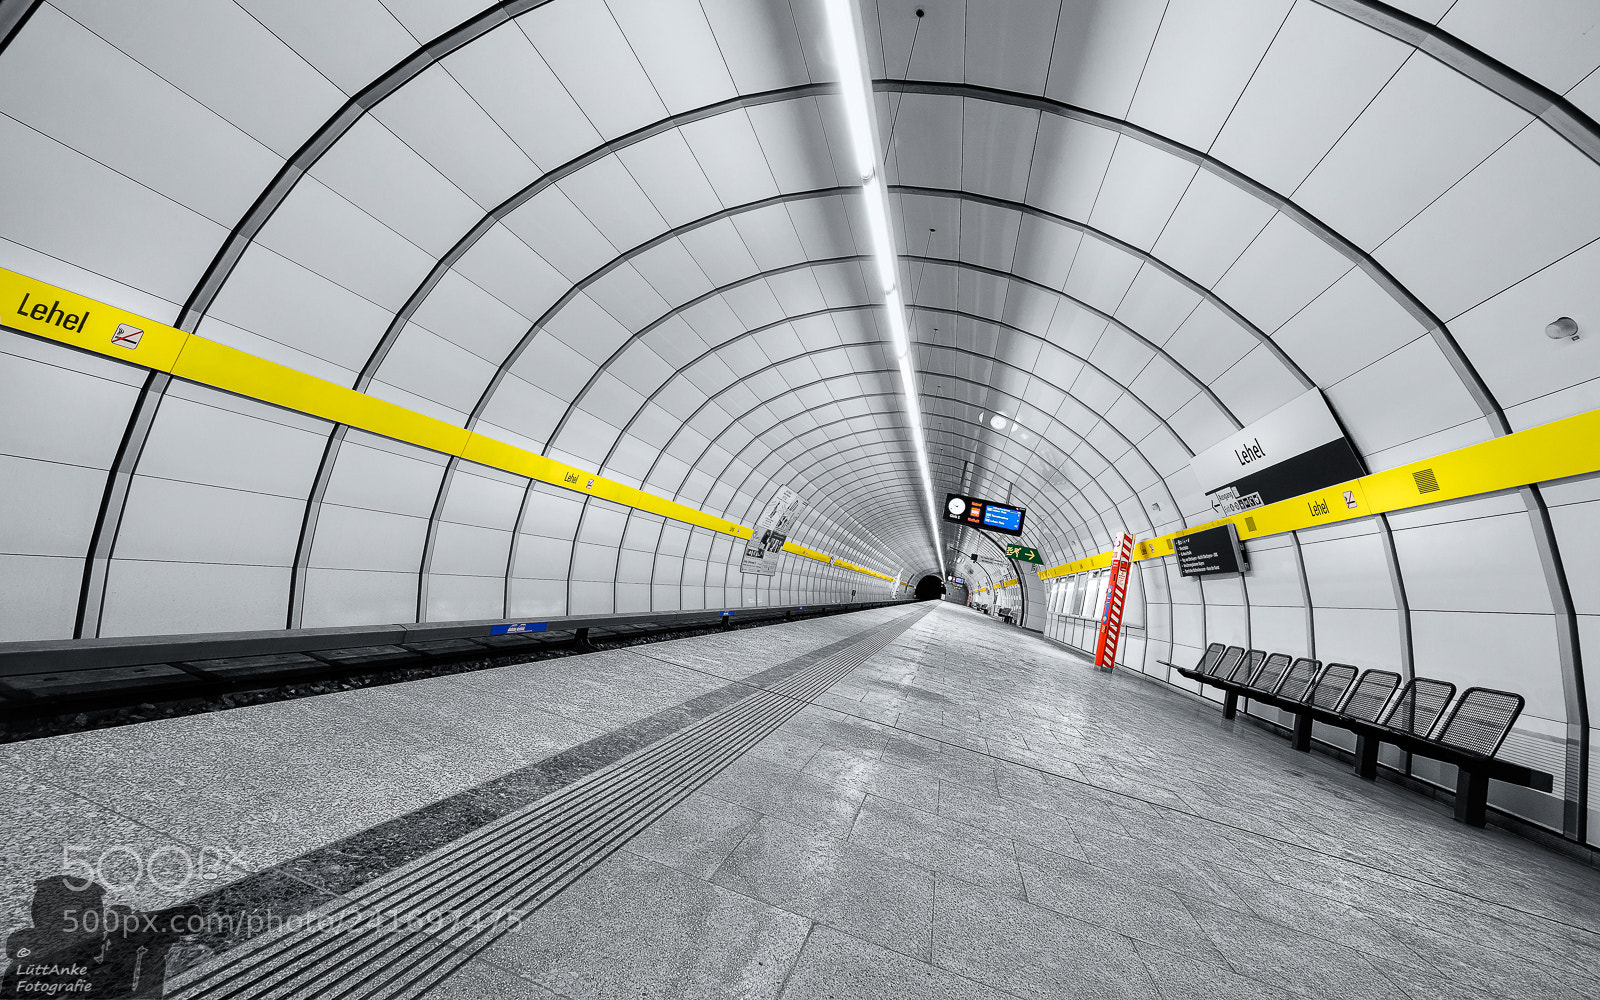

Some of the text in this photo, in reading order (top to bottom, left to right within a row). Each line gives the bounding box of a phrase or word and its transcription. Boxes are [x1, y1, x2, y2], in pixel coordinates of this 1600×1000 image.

[16, 292, 91, 334] Lehel
[1234, 437, 1266, 466] Lehel
[564, 471, 580, 485] Lehel
[1307, 498, 1330, 517] Lehel
